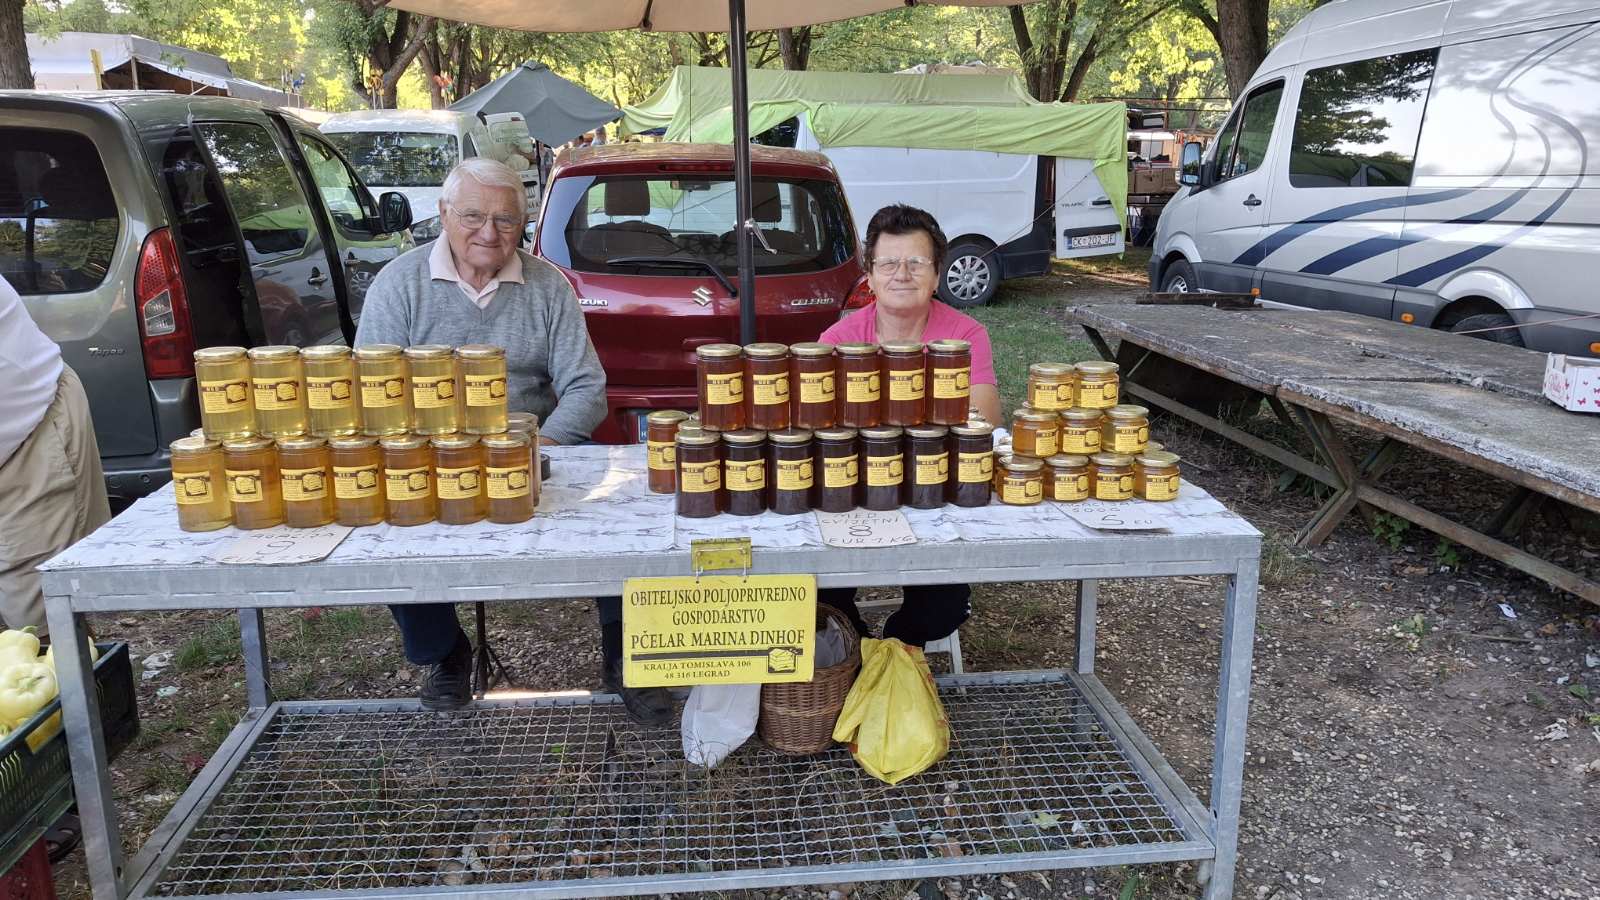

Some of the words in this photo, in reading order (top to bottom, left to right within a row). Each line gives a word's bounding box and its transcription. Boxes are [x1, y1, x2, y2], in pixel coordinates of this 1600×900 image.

[1101, 514, 1125, 526] 5
[848, 525, 873, 537] 8
[631, 589, 700, 608] OBITELJSKO
[703, 587, 806, 606] POLJOPRIVREDNO
[672, 609, 765, 625] GOSPODARSTVO
[631, 630, 686, 649] PČELAR
[691, 632, 747, 648] MARINA
[643, 663, 678, 672] KRALJA
[680, 661, 736, 669] TOMISLAVA
[692, 670, 731, 679] LEGRAD
